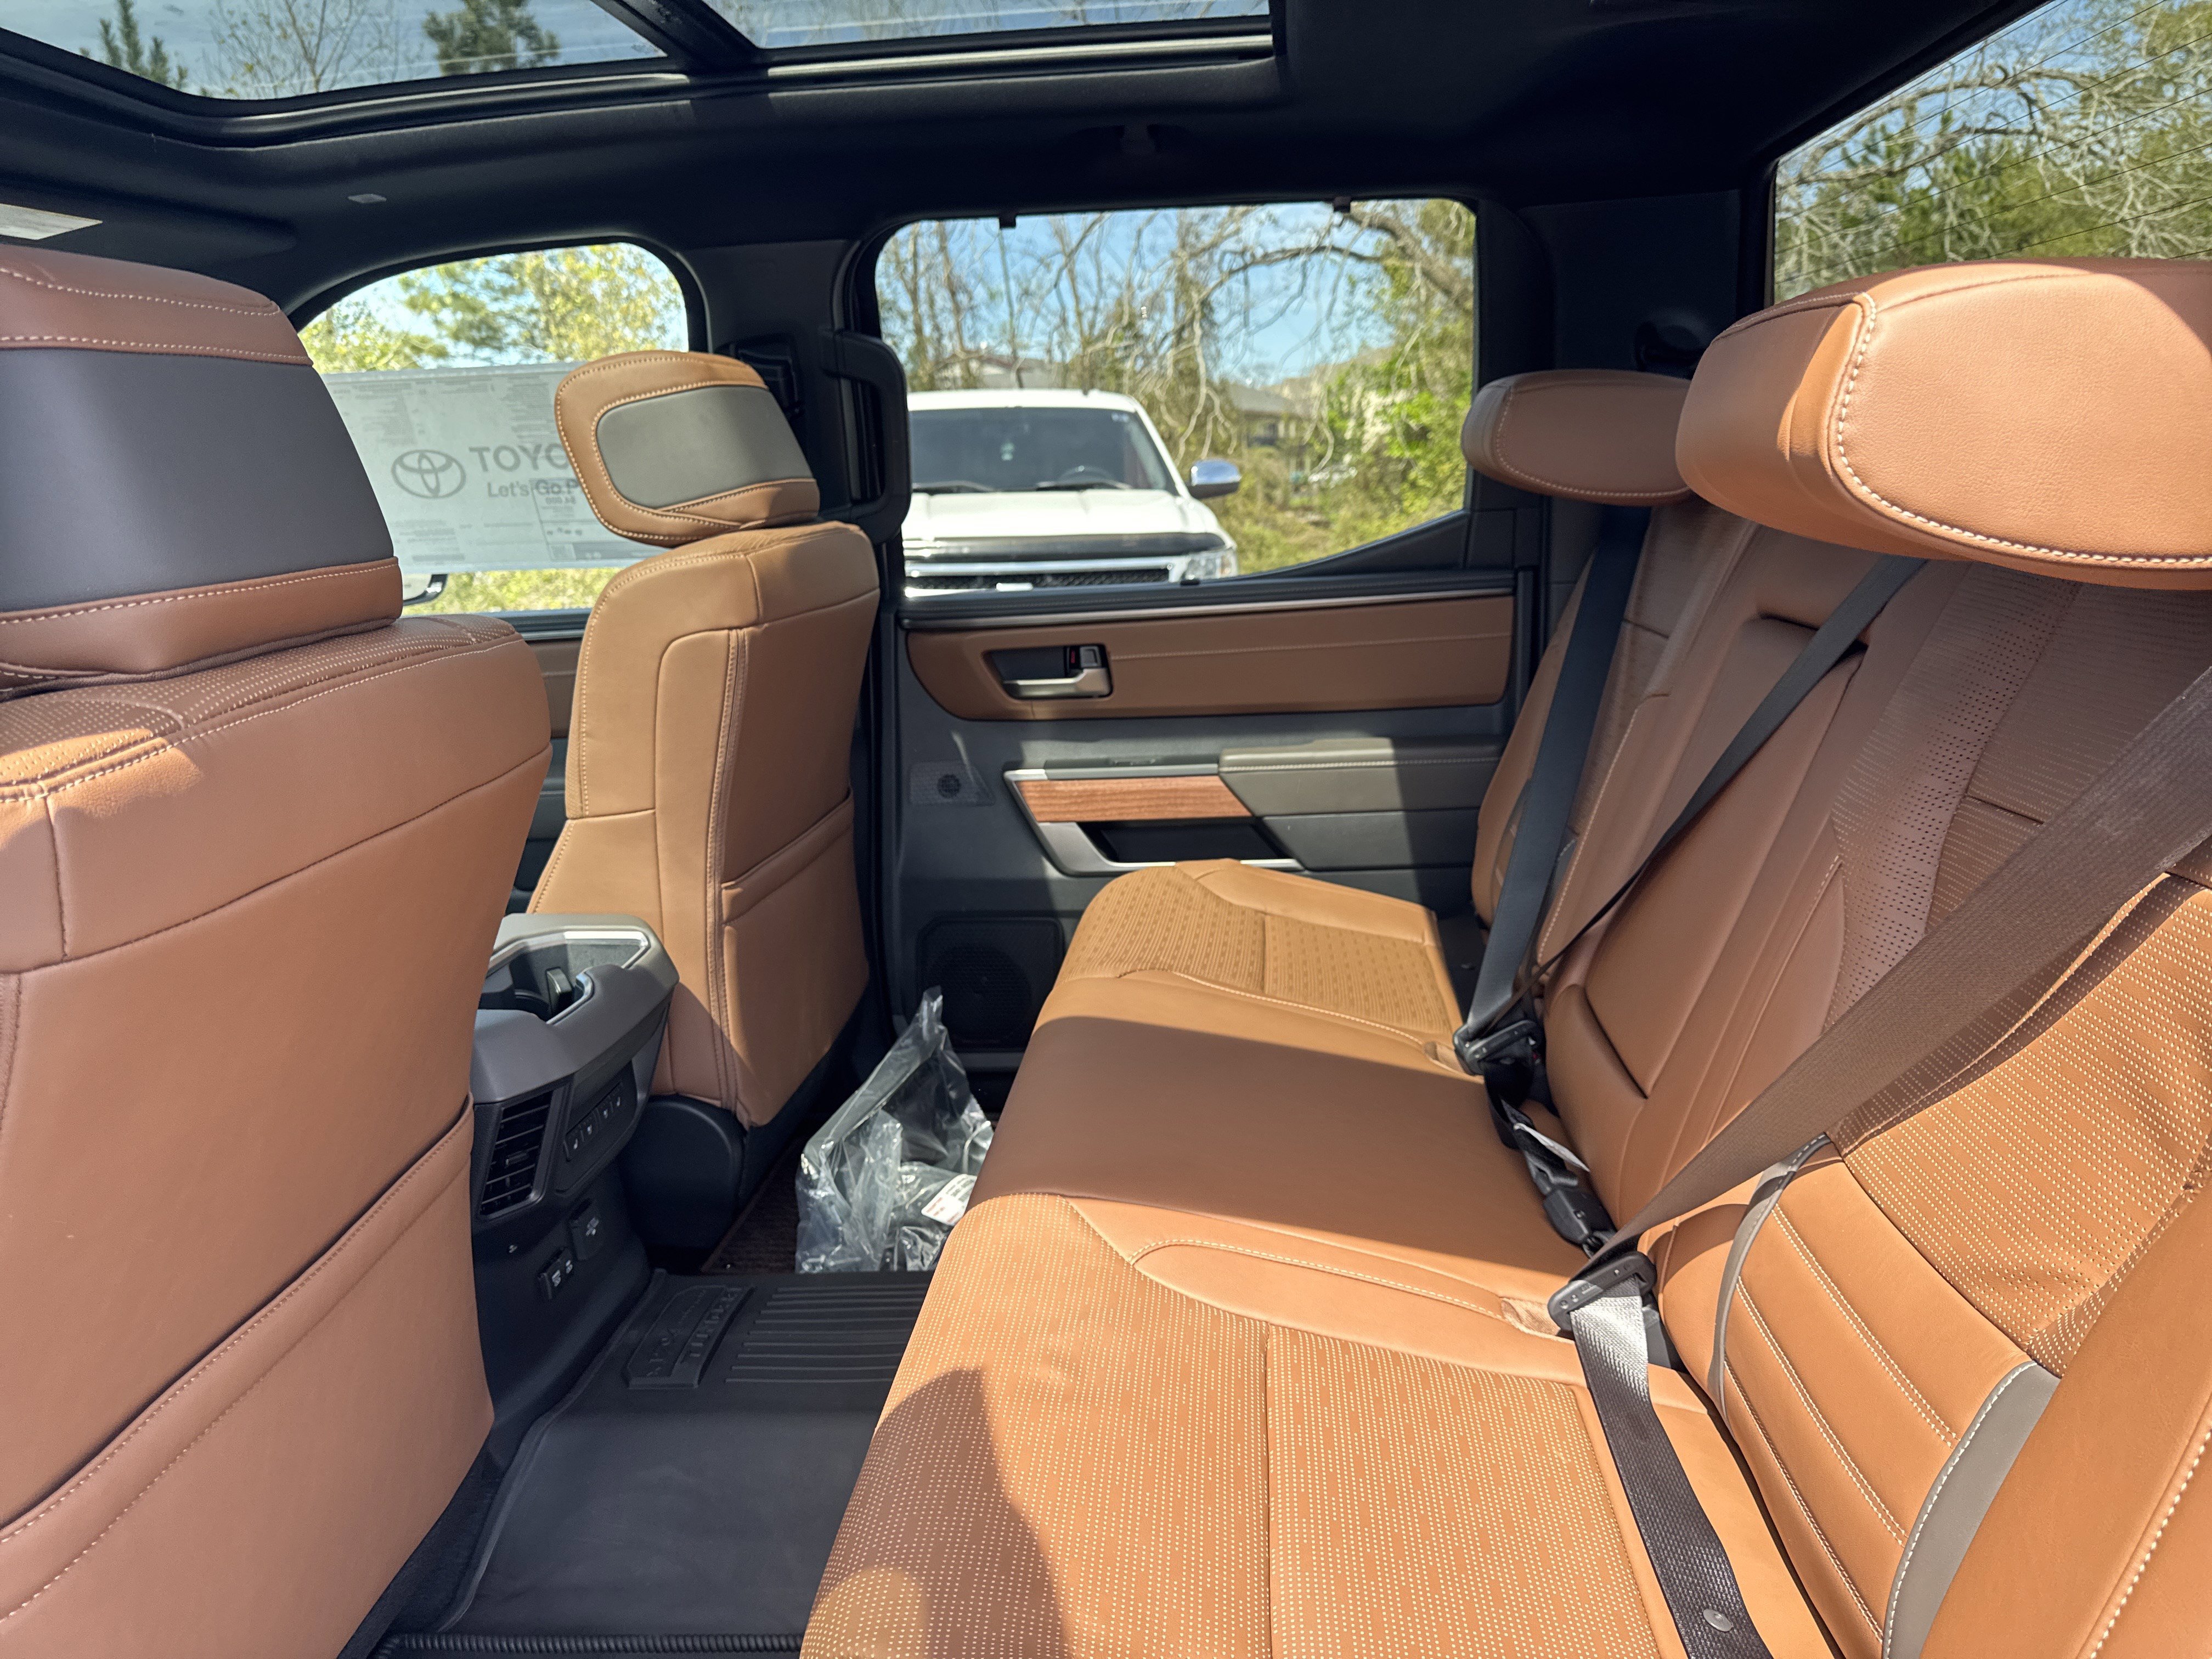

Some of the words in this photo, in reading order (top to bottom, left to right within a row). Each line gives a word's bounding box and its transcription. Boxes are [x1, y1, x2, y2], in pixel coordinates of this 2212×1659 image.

[469, 443, 569, 472] TOYO
[487, 481, 530, 498] Let's
[535, 478, 561, 495] Go
